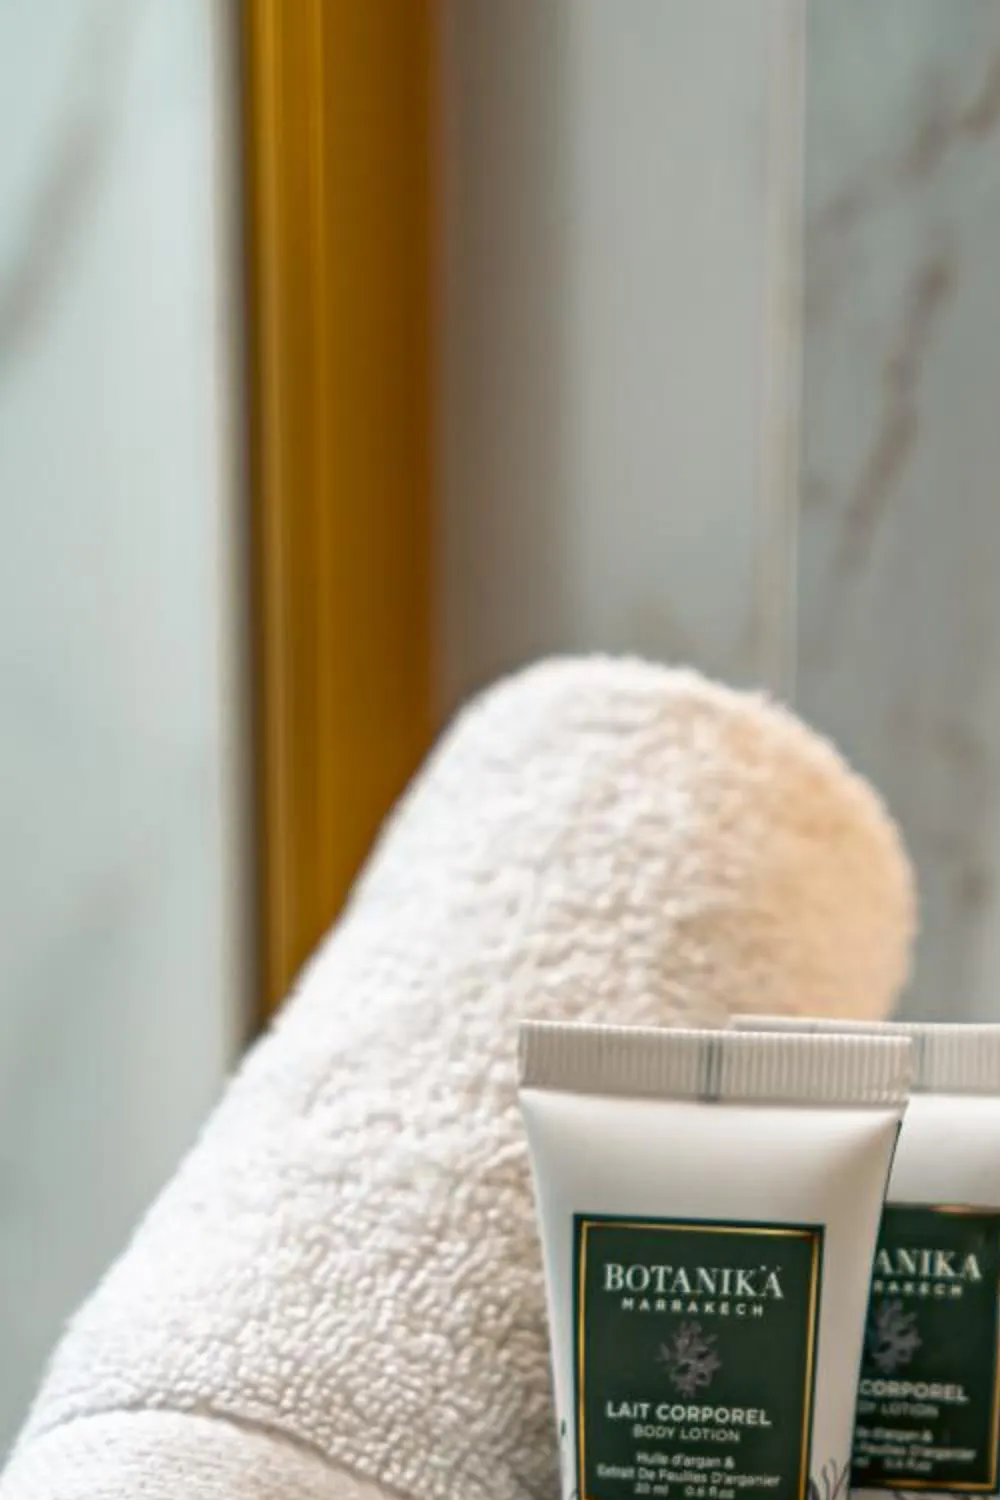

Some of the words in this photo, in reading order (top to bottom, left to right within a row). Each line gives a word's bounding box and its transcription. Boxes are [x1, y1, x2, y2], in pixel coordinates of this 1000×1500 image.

[621, 1297, 764, 1318] MARRAKECH
[606, 1401, 650, 1420] LAIT
[655, 1403, 773, 1427] CORPOREL
[632, 1424, 676, 1440] BODY
[680, 1426, 741, 1443] LOTION
